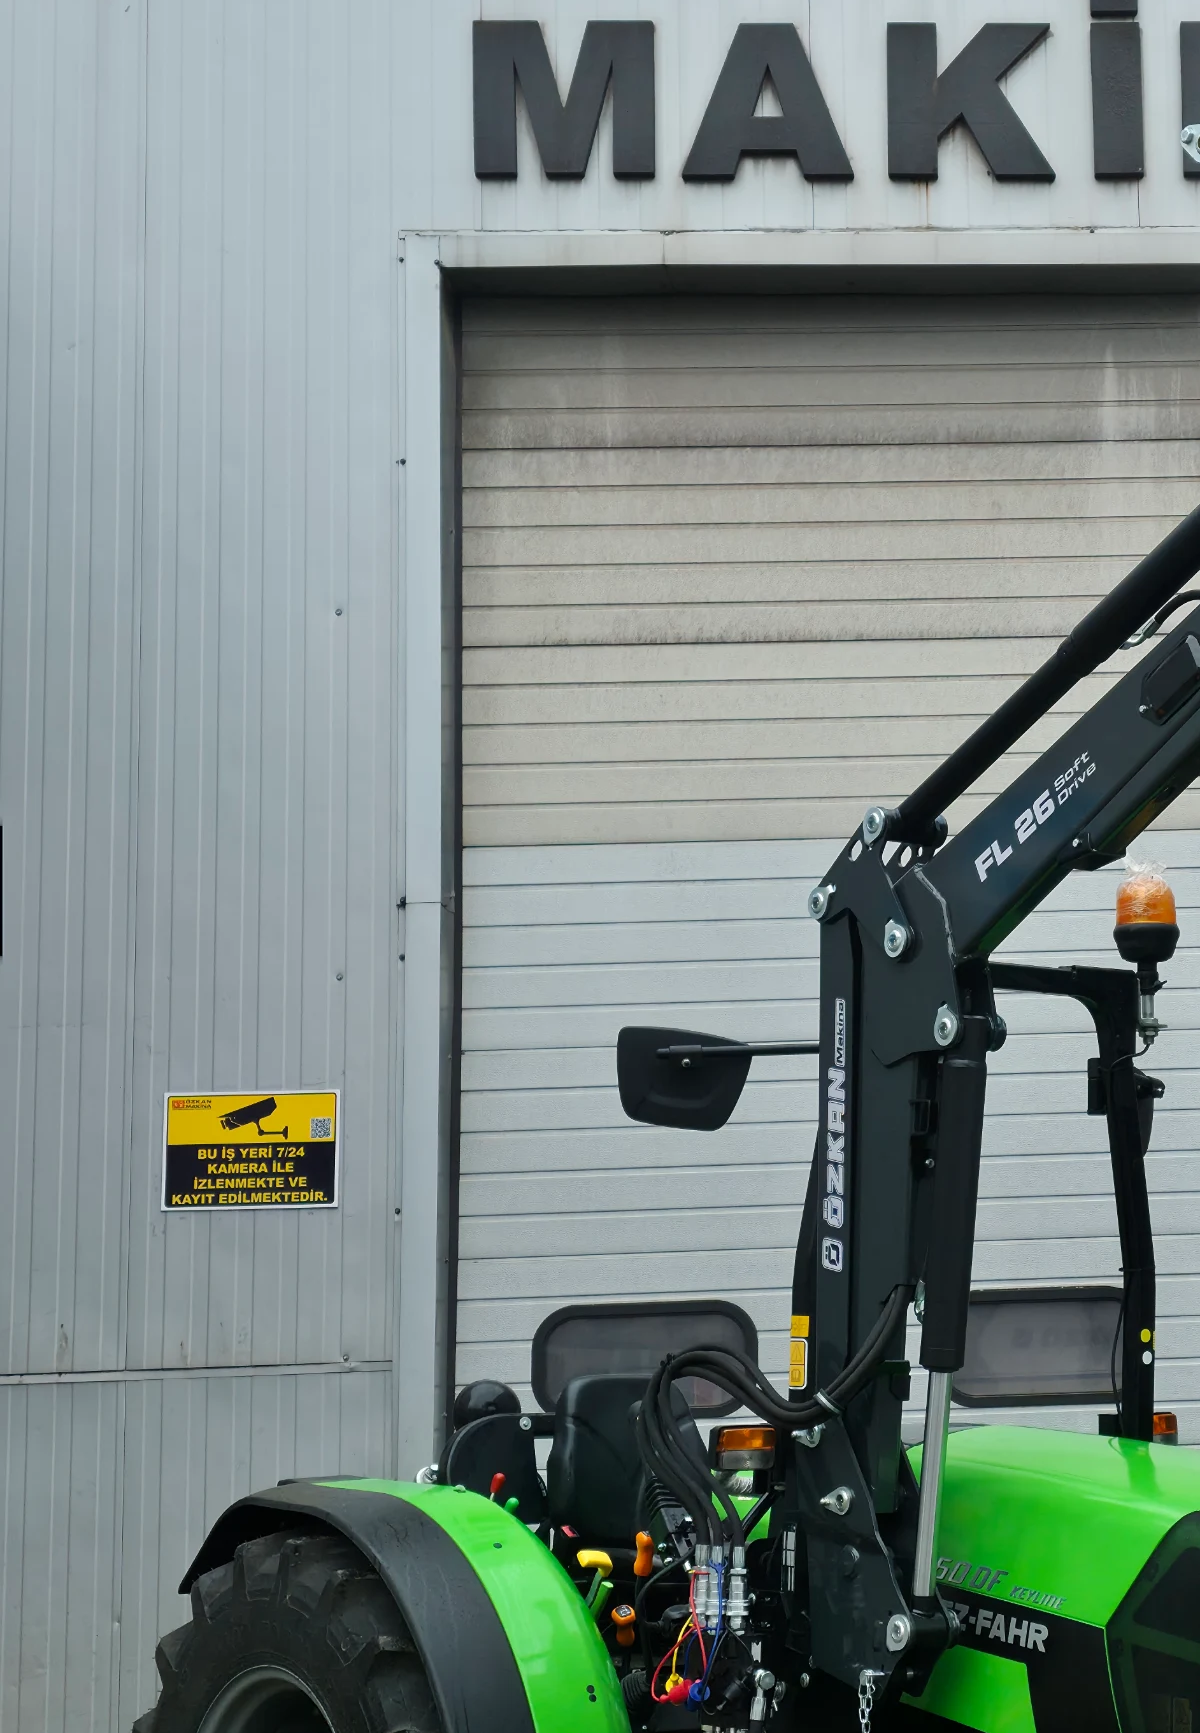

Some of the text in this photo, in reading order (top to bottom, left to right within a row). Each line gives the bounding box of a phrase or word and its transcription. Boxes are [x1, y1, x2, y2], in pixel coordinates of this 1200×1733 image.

[1053, 750, 1091, 792] Soft
[1057, 761, 1097, 806] Drive
[974, 788, 1056, 883] FL 26
[822, 1067, 846, 1229] ÖZKAN
[836, 1002, 844, 1064] Makina
[197, 1145, 305, 1161] BU İŞ YERİ 7/24
[207, 1162, 295, 1175] KAMERA İLE
[171, 1189, 328, 1205] KAYIT EDİLMEKTEDİR.
[193, 1177, 308, 1190] İZLENMEKTE VE
[943, 1599, 1049, 1653] Z-FAHR
